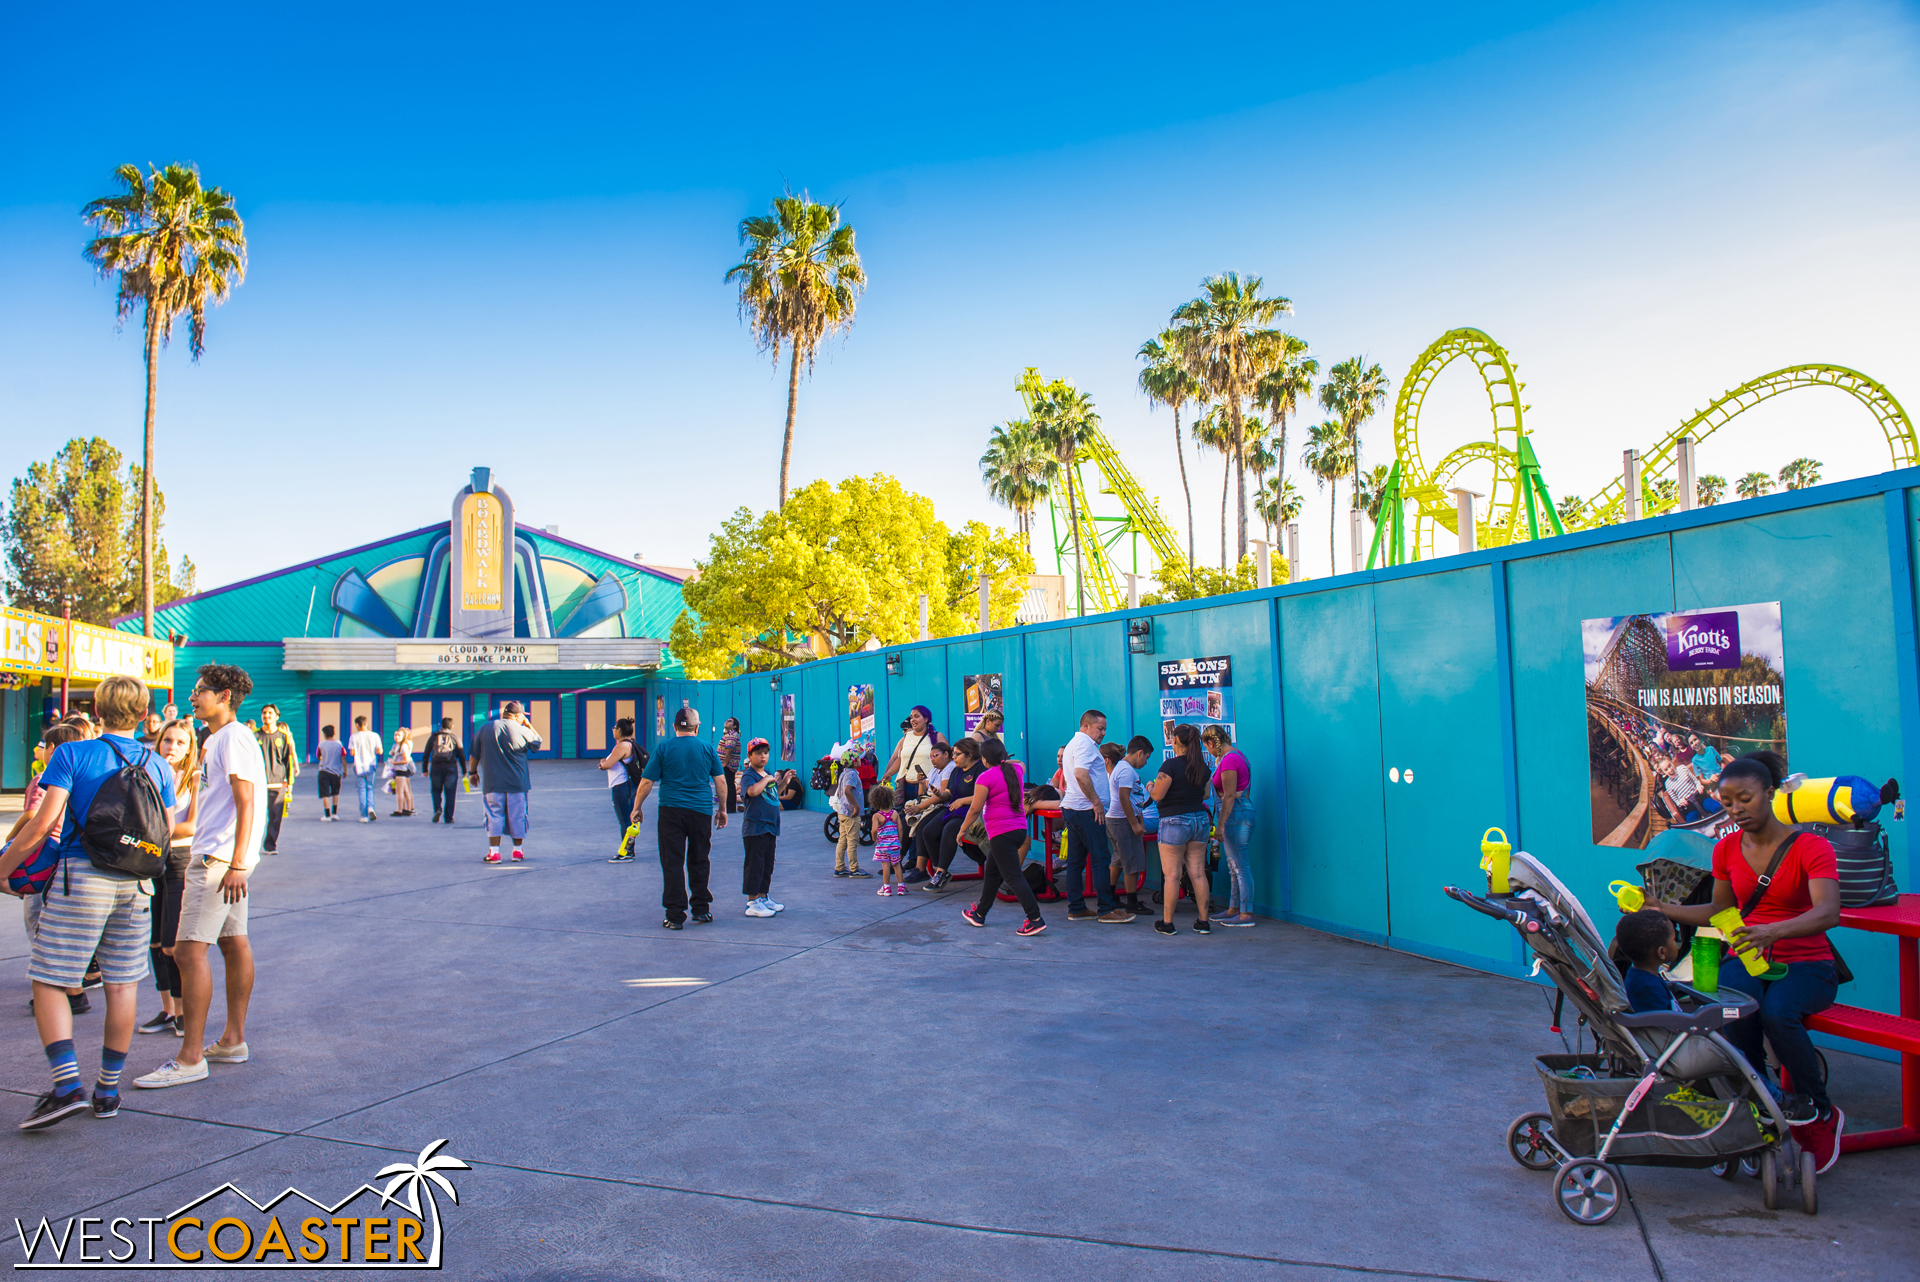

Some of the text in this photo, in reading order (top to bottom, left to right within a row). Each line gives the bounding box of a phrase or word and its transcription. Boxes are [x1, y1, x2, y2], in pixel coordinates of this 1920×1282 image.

[474, 498, 491, 588] BOARDWALK
[465, 592, 501, 605] BALLROOM
[0, 616, 42, 664] ES
[1677, 624, 1730, 654] Knott's
[74, 633, 144, 678] GAMES
[154, 649, 169, 680] fun
[449, 645, 526, 654] CLOUD 9 7PM-10
[1689, 646, 1720, 657] BERRY FARM
[438, 654, 529, 664] 80'S DANCE PARTY
[1161, 659, 1228, 675] SEASONS
[1168, 673, 1220, 686] OF FUN
[1638, 685, 1781, 706] FUN IS ALWAYS IN SEASON
[1162, 699, 1182, 715] SPRING
